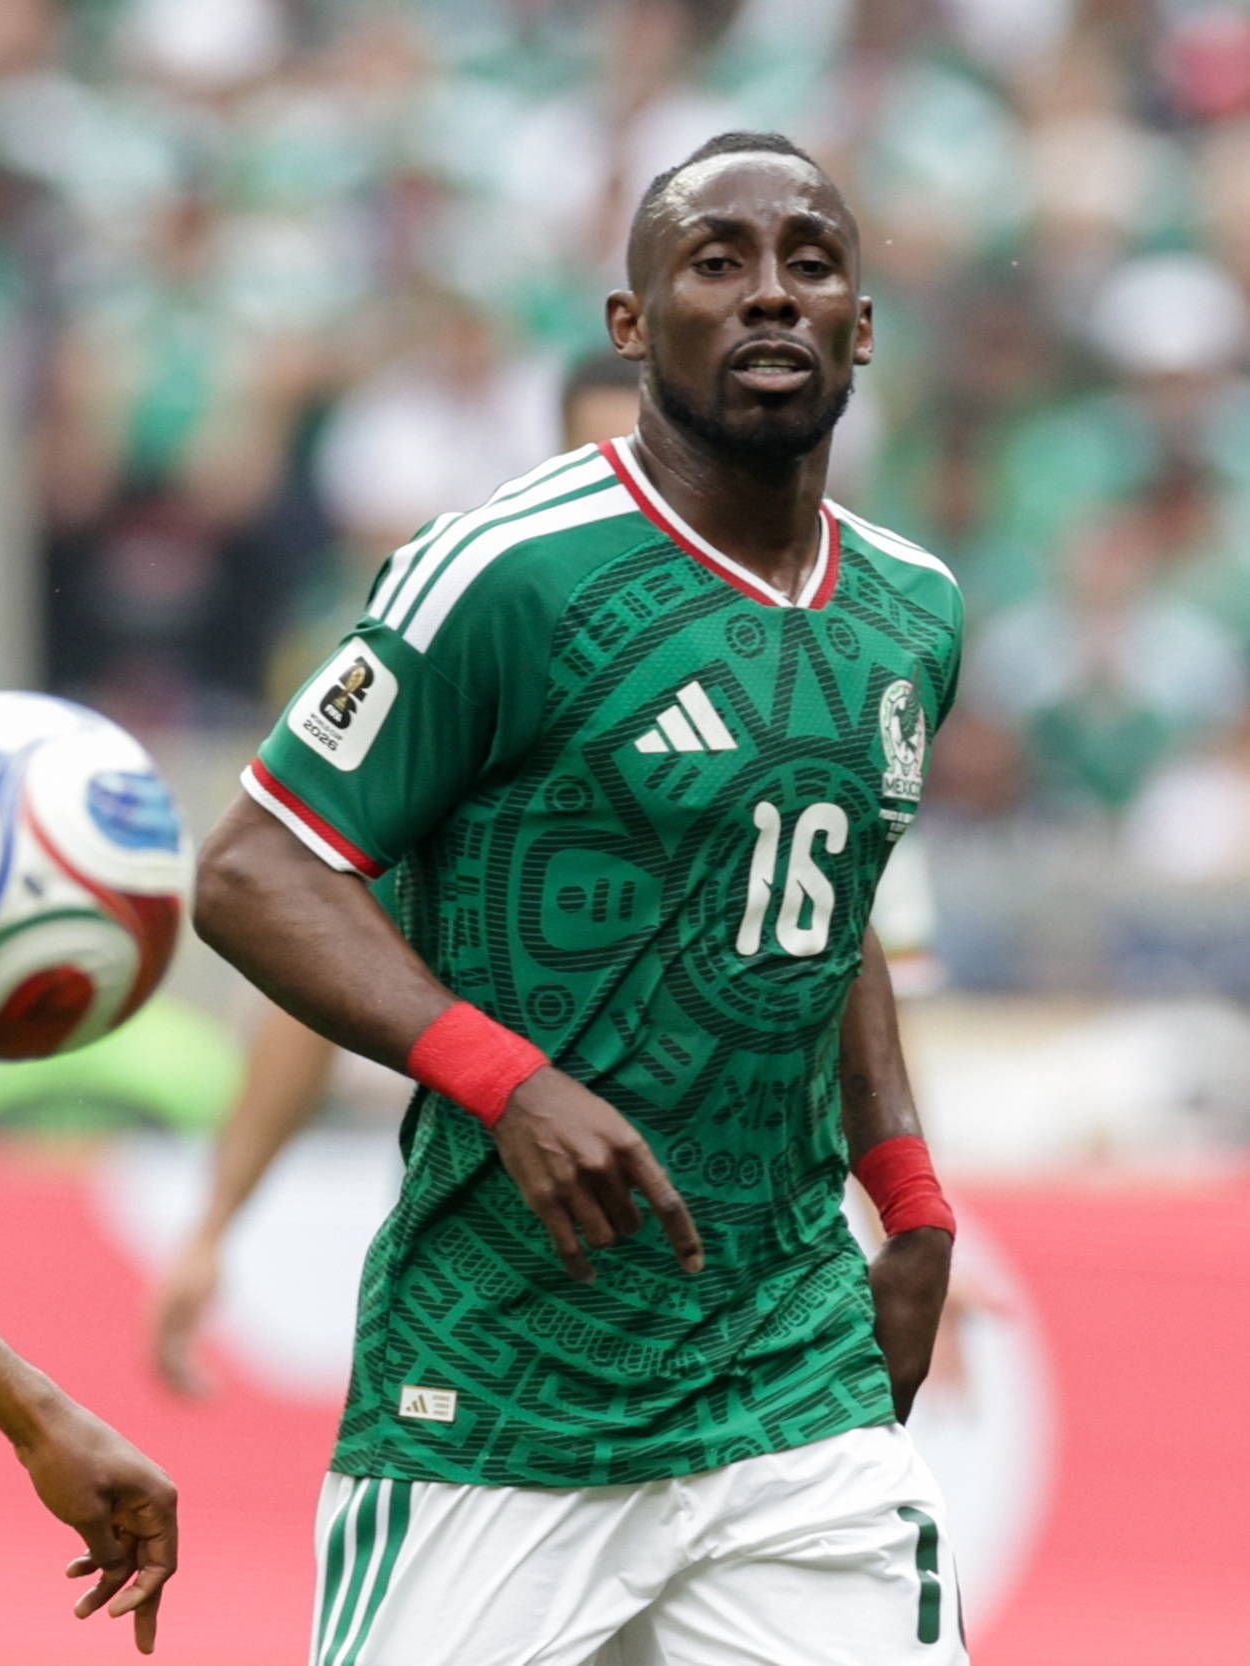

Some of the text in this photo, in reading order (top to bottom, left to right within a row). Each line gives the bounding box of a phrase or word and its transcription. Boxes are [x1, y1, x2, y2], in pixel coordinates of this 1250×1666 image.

[324, 704, 344, 722] FIFA
[303, 720, 338, 751] 2026
[736, 801, 848, 957] 16
